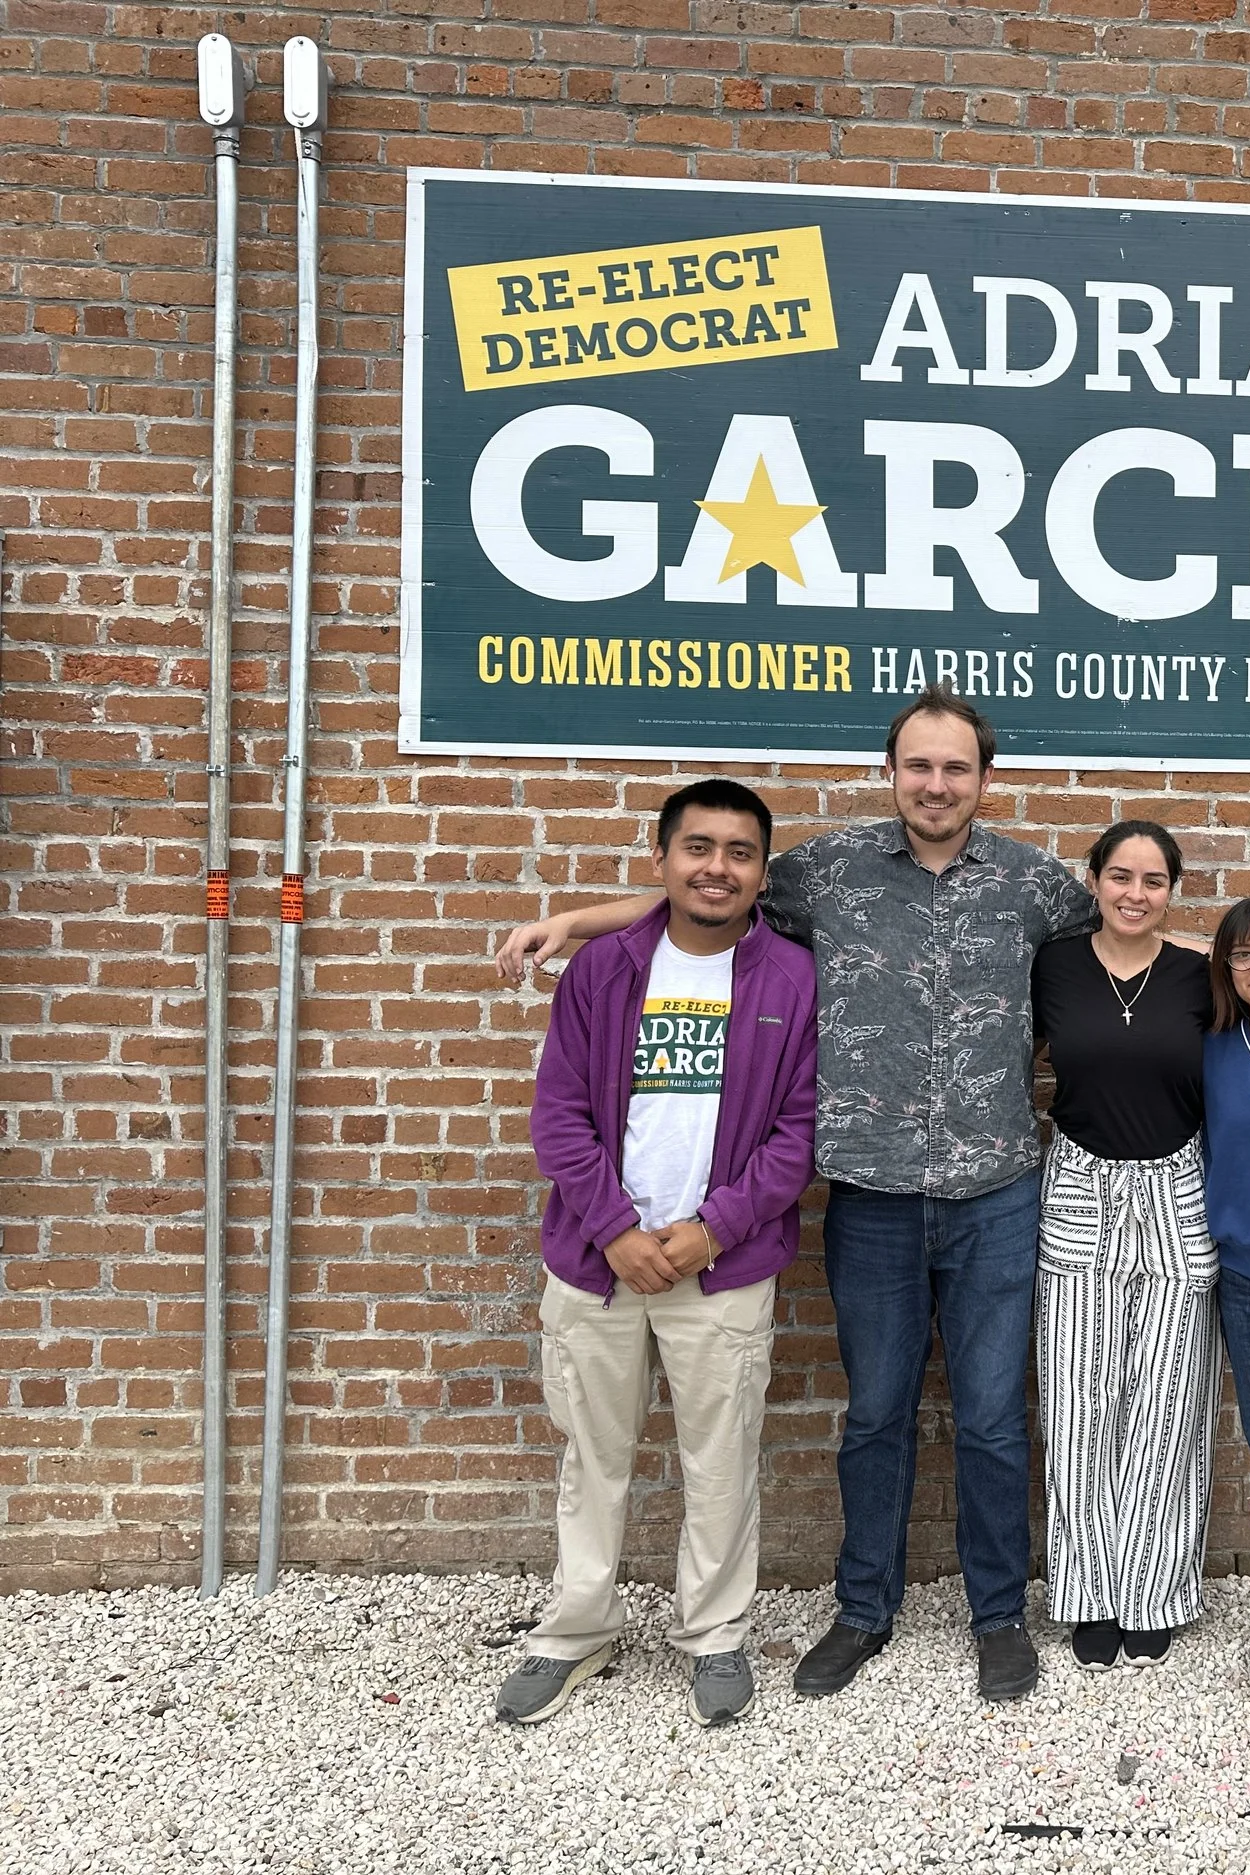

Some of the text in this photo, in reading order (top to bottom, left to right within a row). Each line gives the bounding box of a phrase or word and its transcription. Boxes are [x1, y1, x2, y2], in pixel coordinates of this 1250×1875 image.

[497, 245, 779, 316] RE-ELECT
[481, 298, 811, 374] DEMOCRAT
[478, 635, 852, 692] COMMISSIONER
[872, 647, 1034, 698] HARRIS
[1055, 653, 1226, 702] COUNTY
[633, 1048, 724, 1076] GARCI
[638, 1018, 726, 1046] ADRIA
